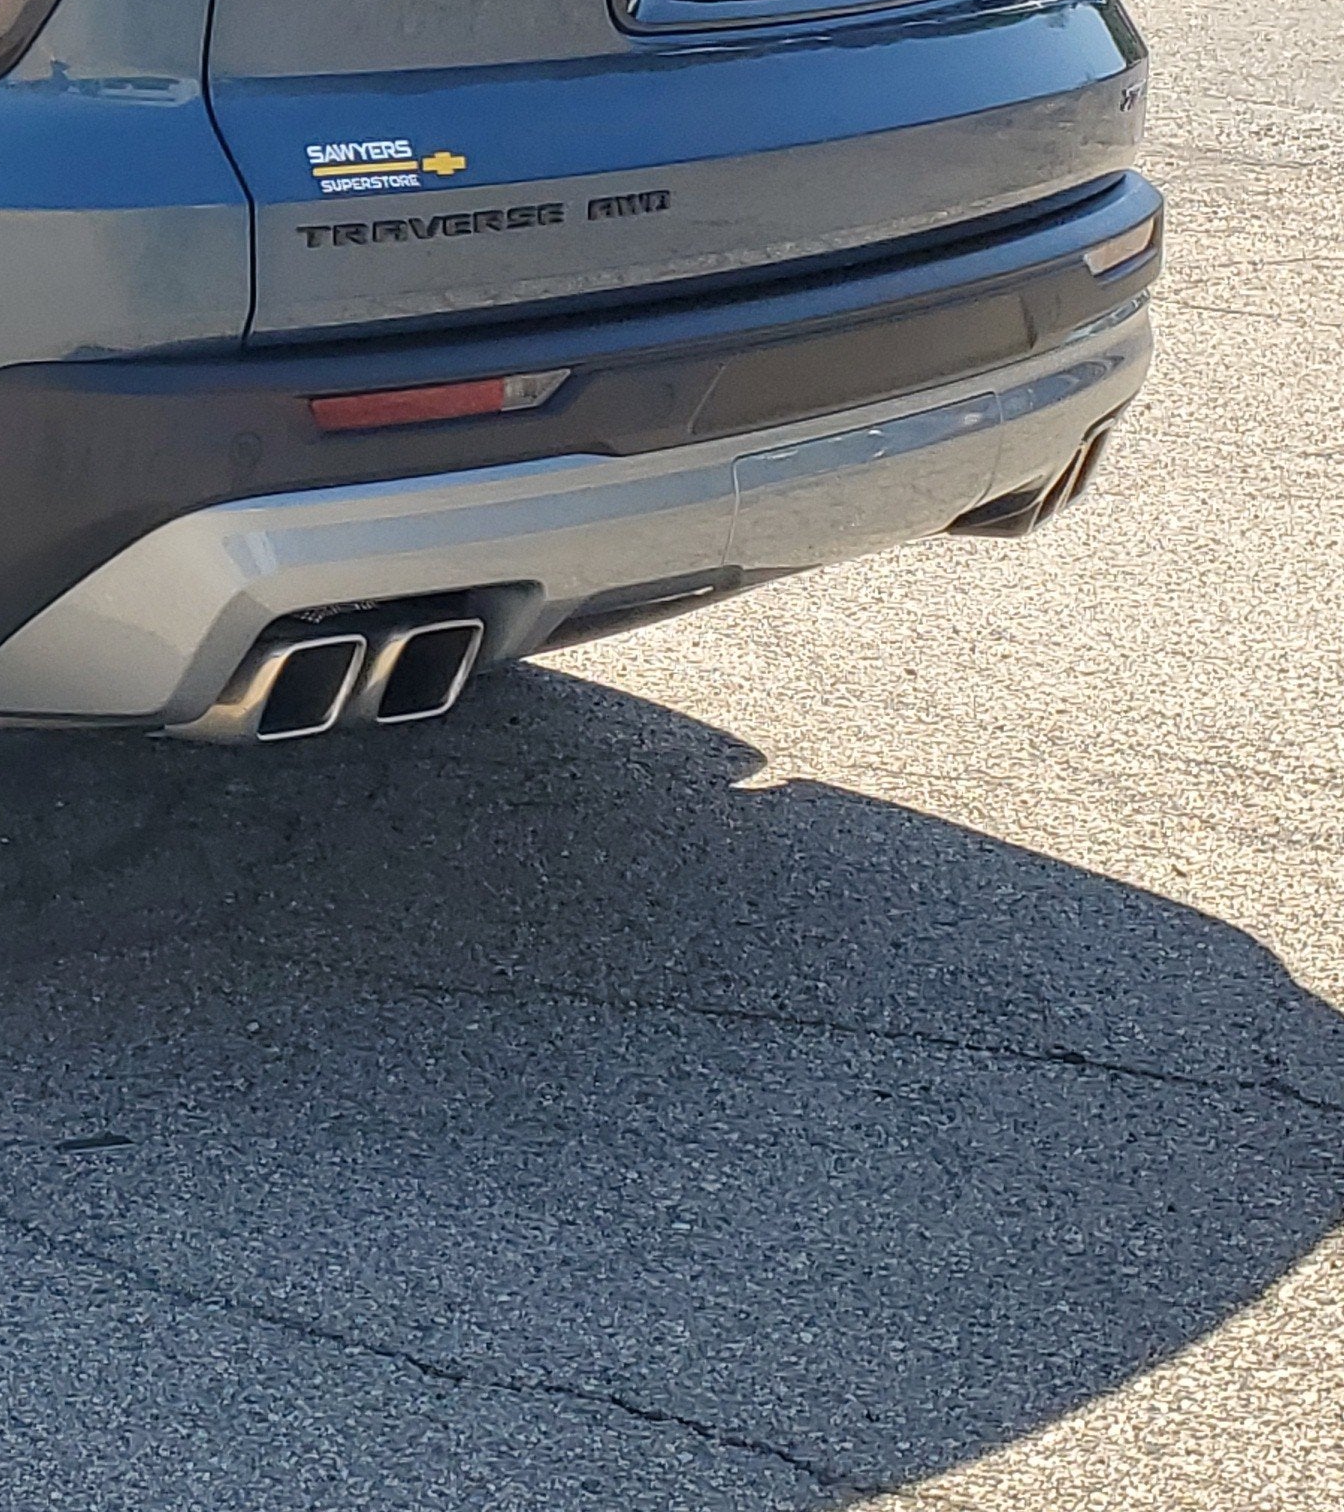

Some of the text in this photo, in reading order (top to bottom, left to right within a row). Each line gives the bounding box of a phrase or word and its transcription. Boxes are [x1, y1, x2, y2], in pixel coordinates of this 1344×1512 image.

[306, 139, 413, 164] SAWYERS
[320, 172, 421, 194] SUPERSTORE
[295, 189, 672, 249] TRAVERSE AWD
